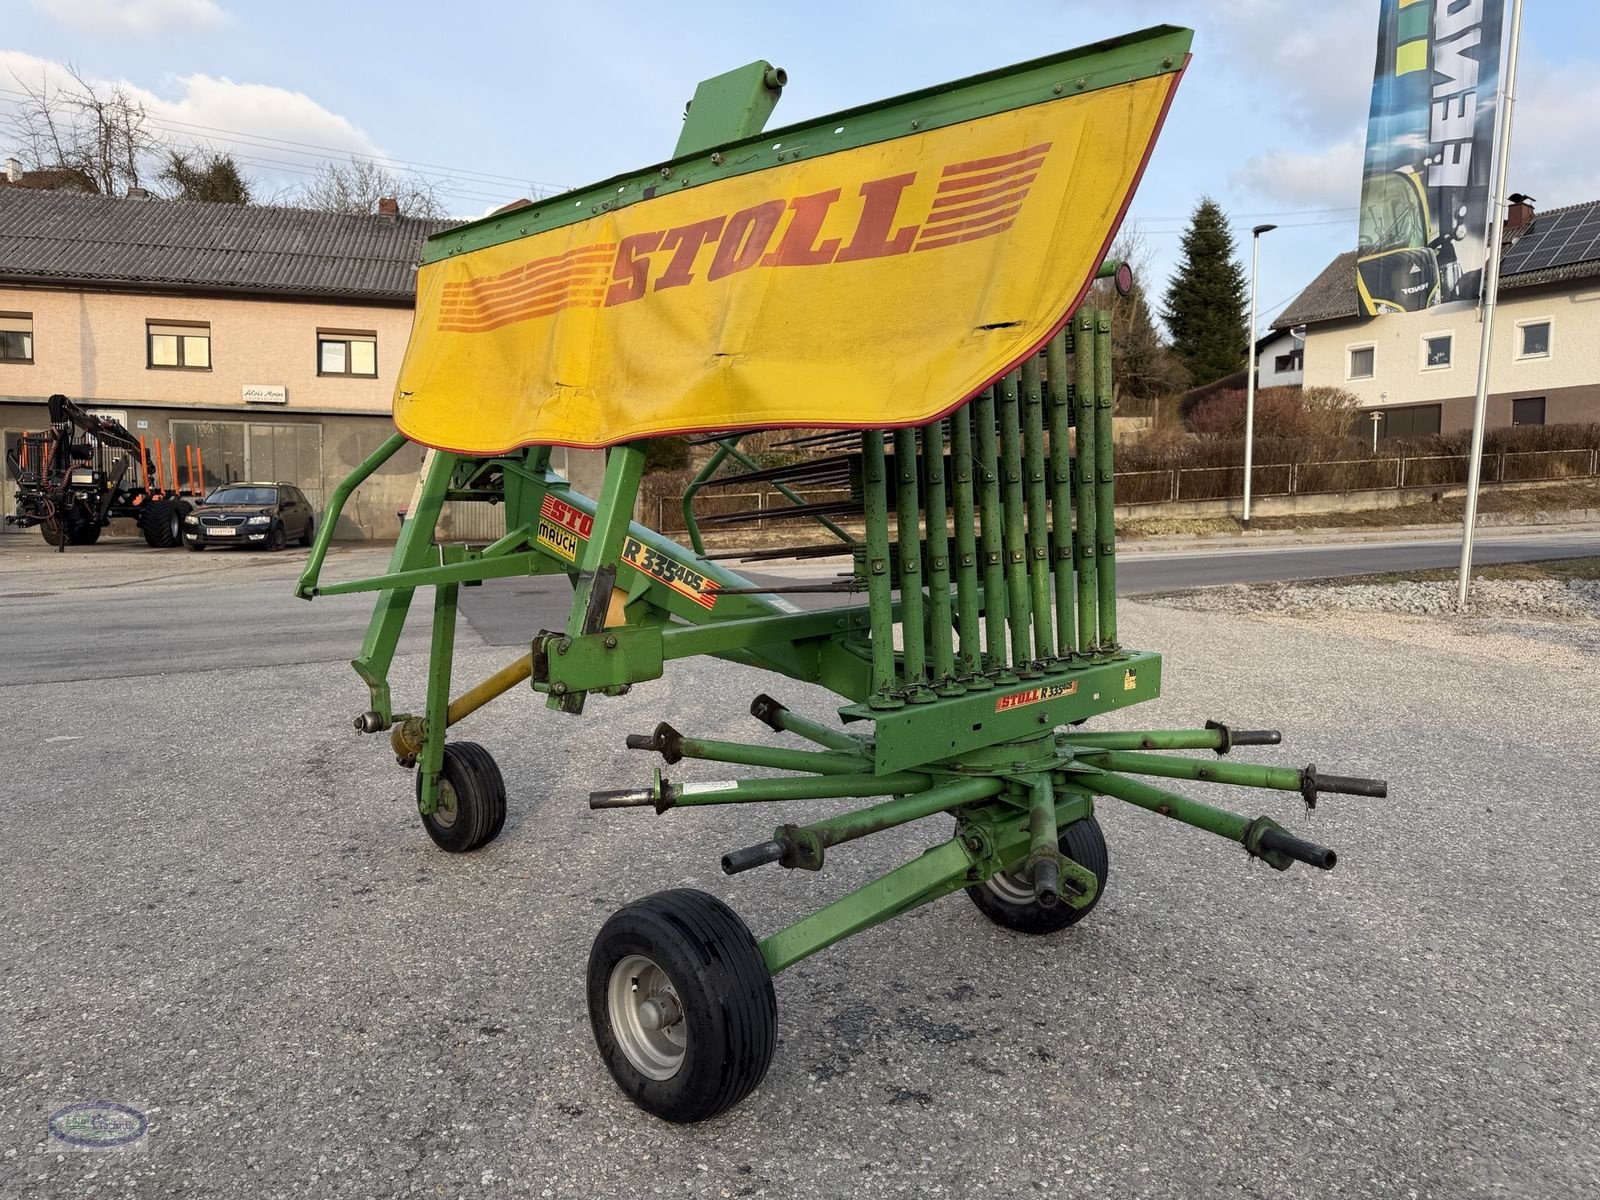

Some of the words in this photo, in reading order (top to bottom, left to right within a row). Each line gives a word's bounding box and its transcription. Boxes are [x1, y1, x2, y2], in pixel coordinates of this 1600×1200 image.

[604, 171, 920, 307] STOLL
[539, 523, 576, 554] MAUCH
[624, 539, 642, 563] R
[1002, 689, 1039, 708] STOLL
[1040, 687, 1049, 699] R
